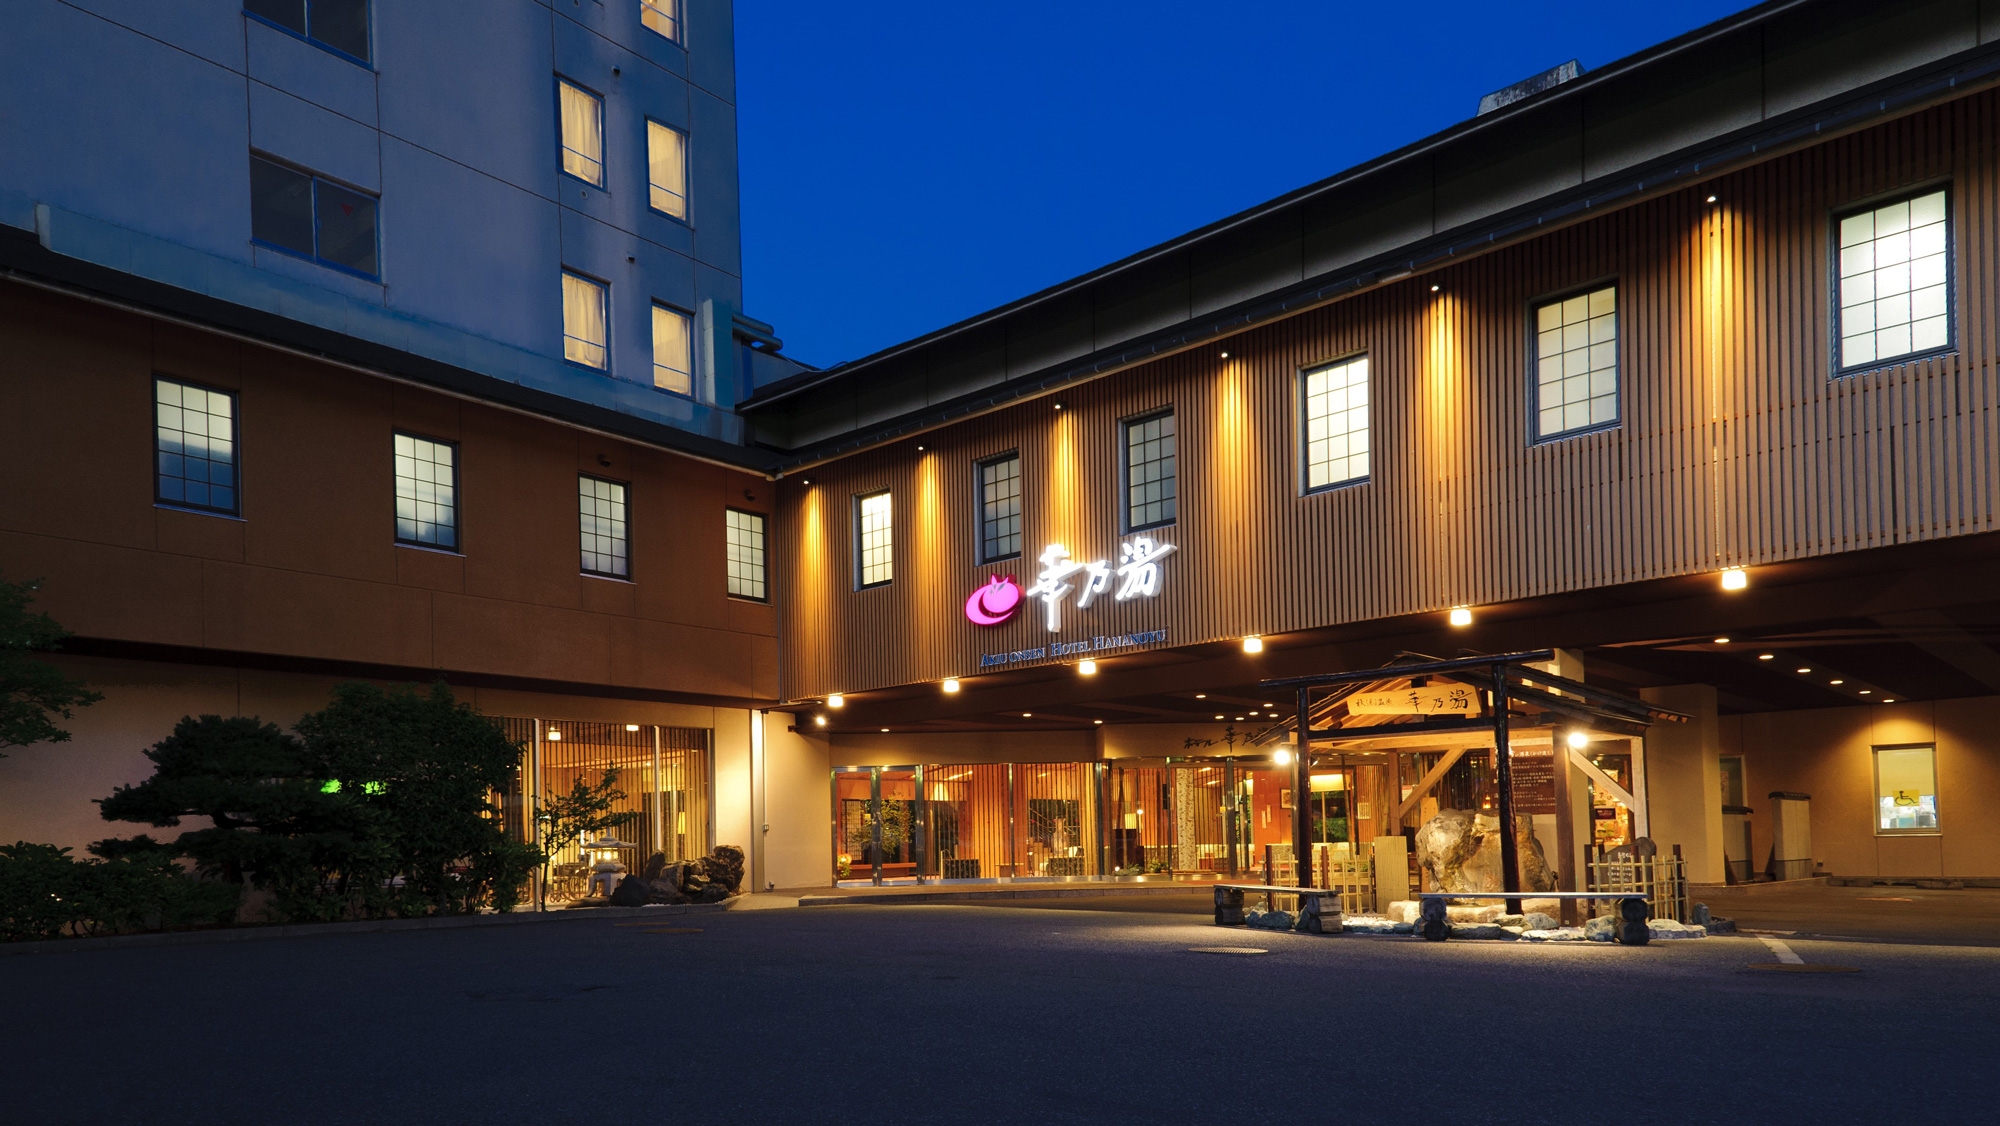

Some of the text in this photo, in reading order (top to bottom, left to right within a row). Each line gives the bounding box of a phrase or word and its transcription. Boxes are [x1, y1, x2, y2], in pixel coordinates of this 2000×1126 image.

[1027, 536, 1177, 632] 華乃湯
[980, 629, 1167, 668] AKIU ONSEN HOTEL HANANOYU
[1184, 736, 1218, 749] ホテル
